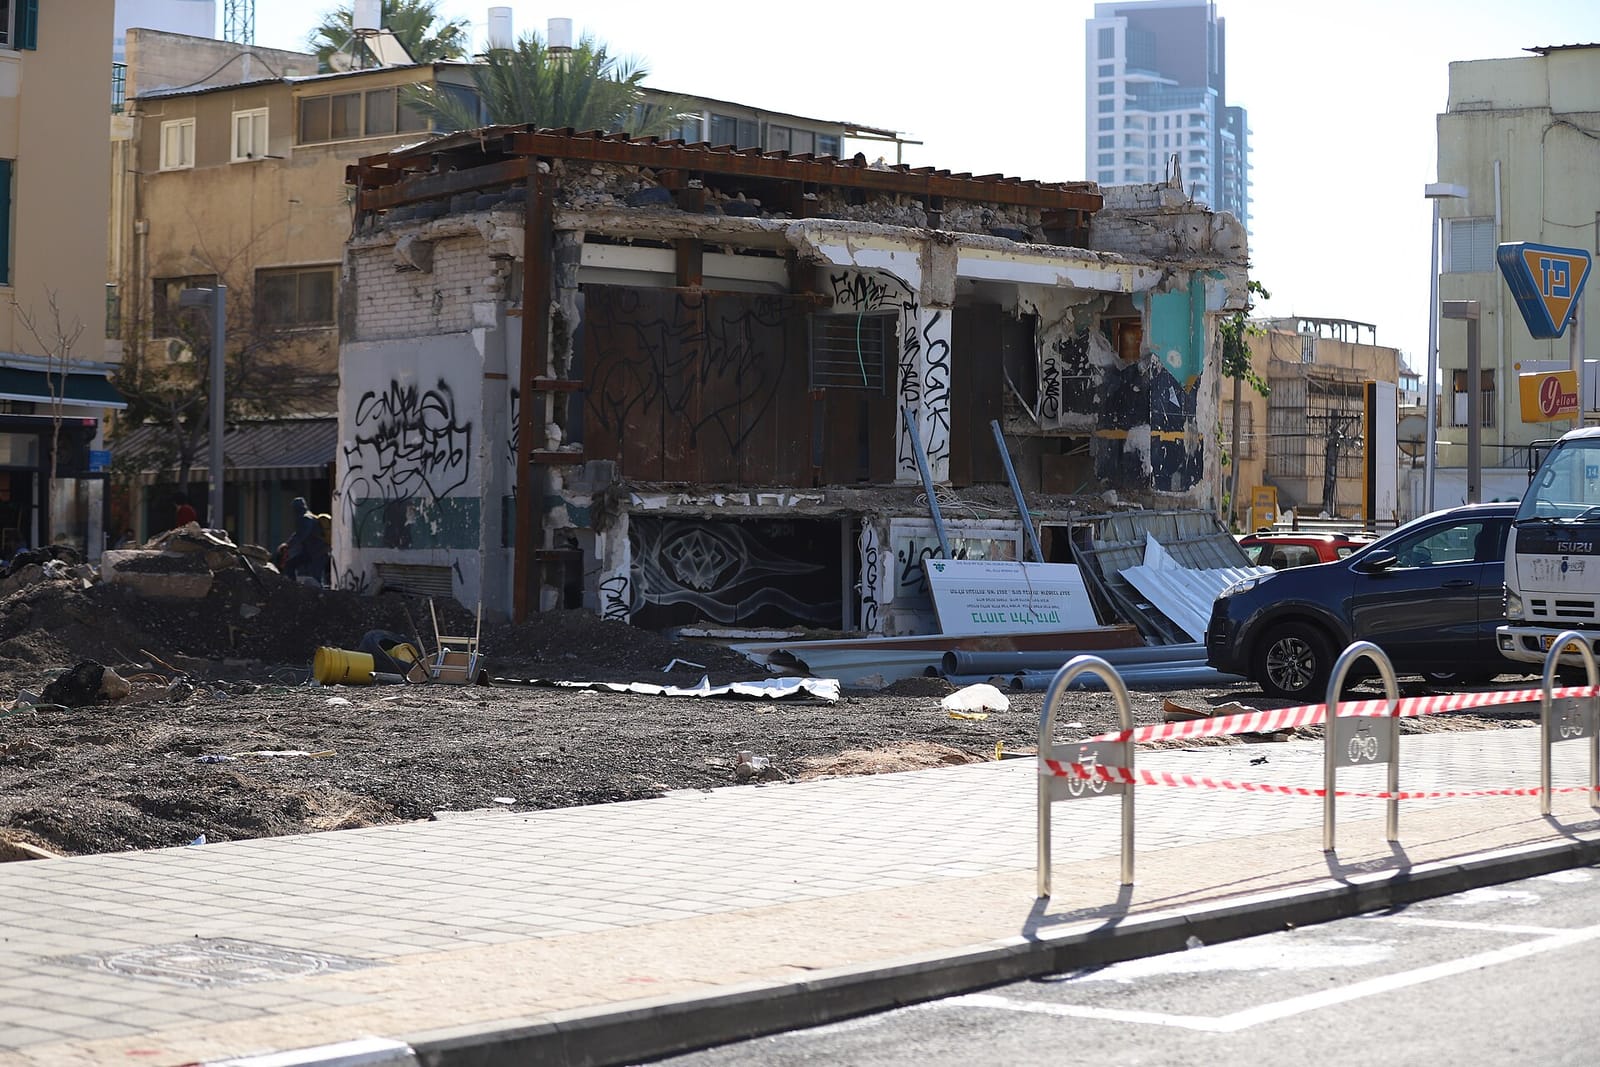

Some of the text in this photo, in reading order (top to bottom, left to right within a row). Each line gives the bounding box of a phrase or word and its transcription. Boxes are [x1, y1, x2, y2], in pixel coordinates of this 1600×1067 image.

[1540, 257, 1571, 299] פז
[1557, 542, 1593, 553] ISUZU
[971, 612, 1007, 623] ברחוב
[1009, 612, 1034, 625] הלל
